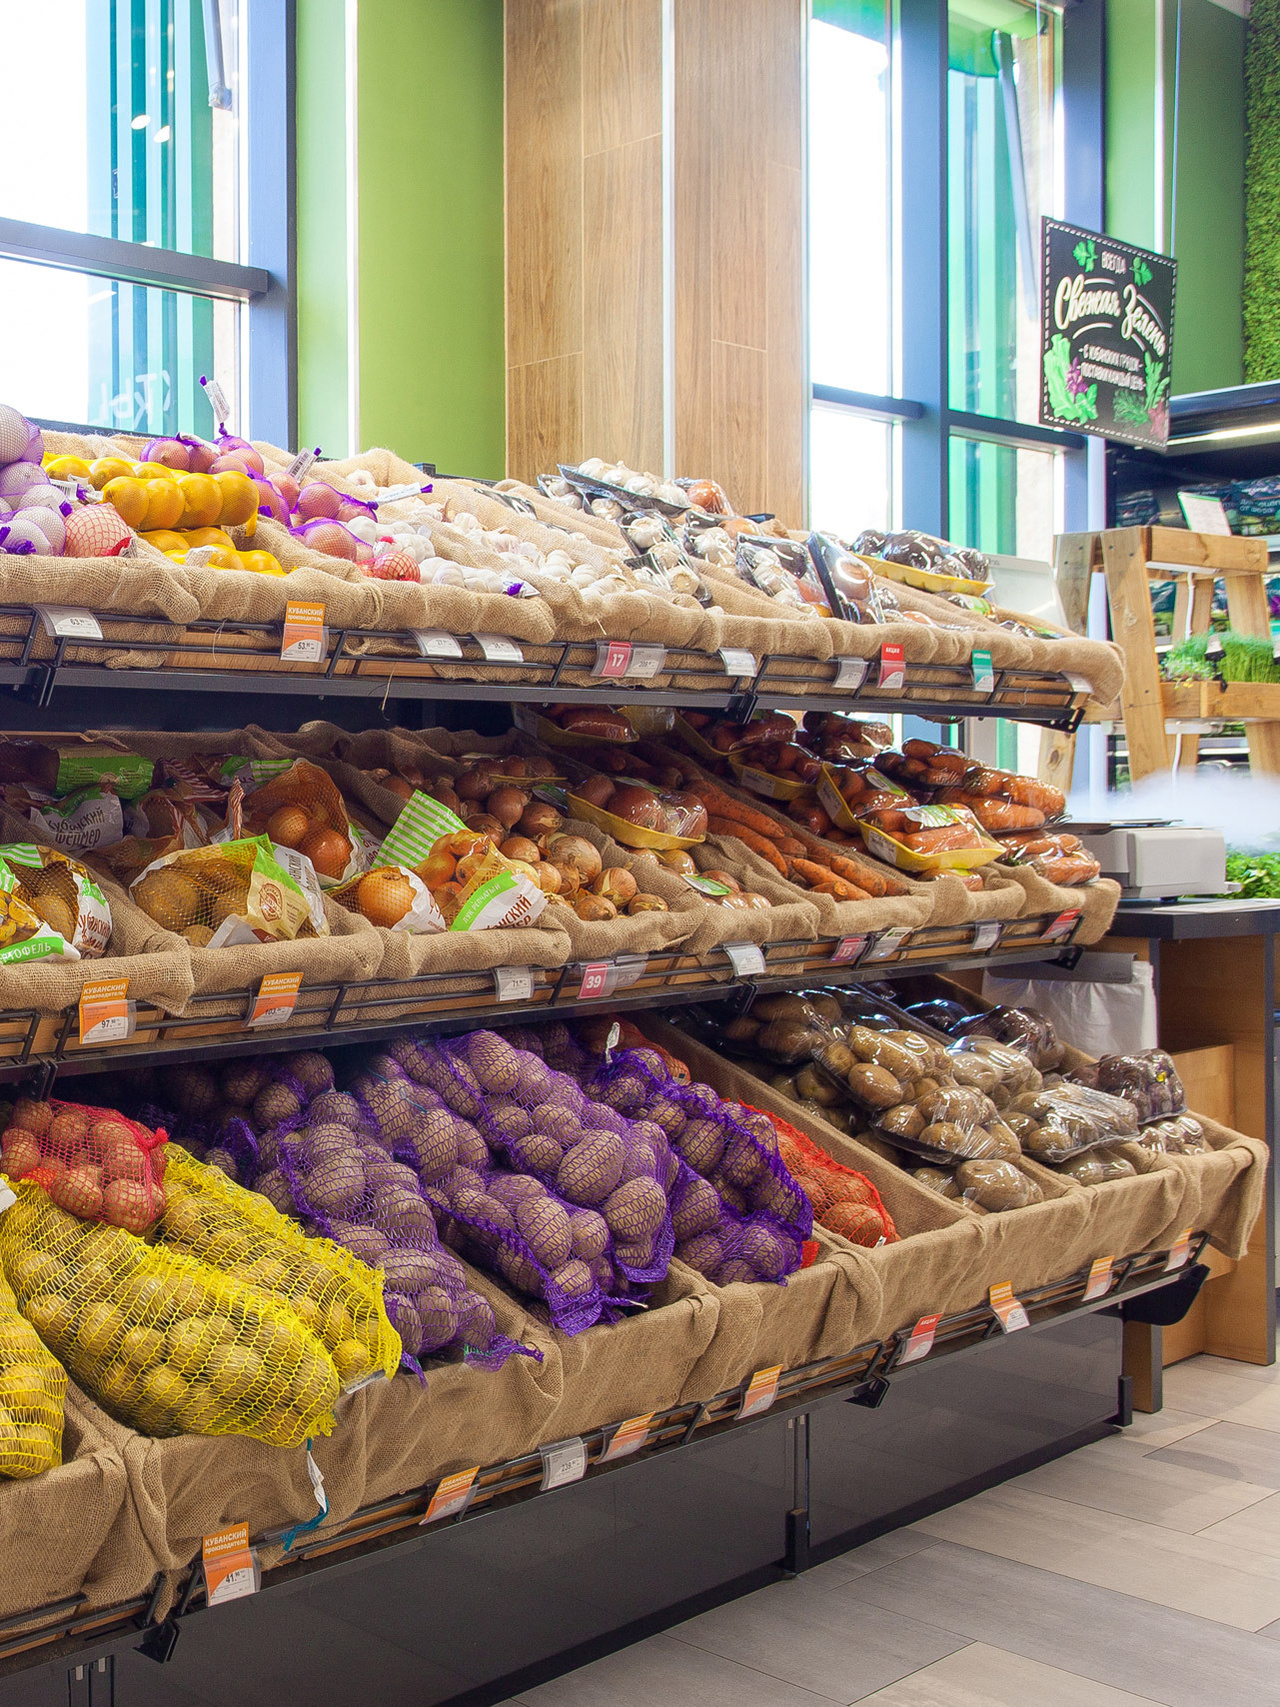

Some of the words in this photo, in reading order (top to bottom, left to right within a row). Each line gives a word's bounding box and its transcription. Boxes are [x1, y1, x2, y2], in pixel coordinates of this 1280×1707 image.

[1101, 251, 1127, 274] ВСЕГДА
[1054, 274, 1121, 330] Свежая
[1120, 283, 1166, 358] Зелень
[288, 606, 323, 616] КУБАНСКИЙ
[612, 653, 625, 667] 17
[83, 982, 126, 995] КУБАНСКИЙ
[263, 976, 300, 988] КУБАНСКИЙ
[586, 975, 602, 990] 39
[204, 1528, 247, 1547] КУБАНСКИЙ
[204, 1538, 247, 1554] производитель
